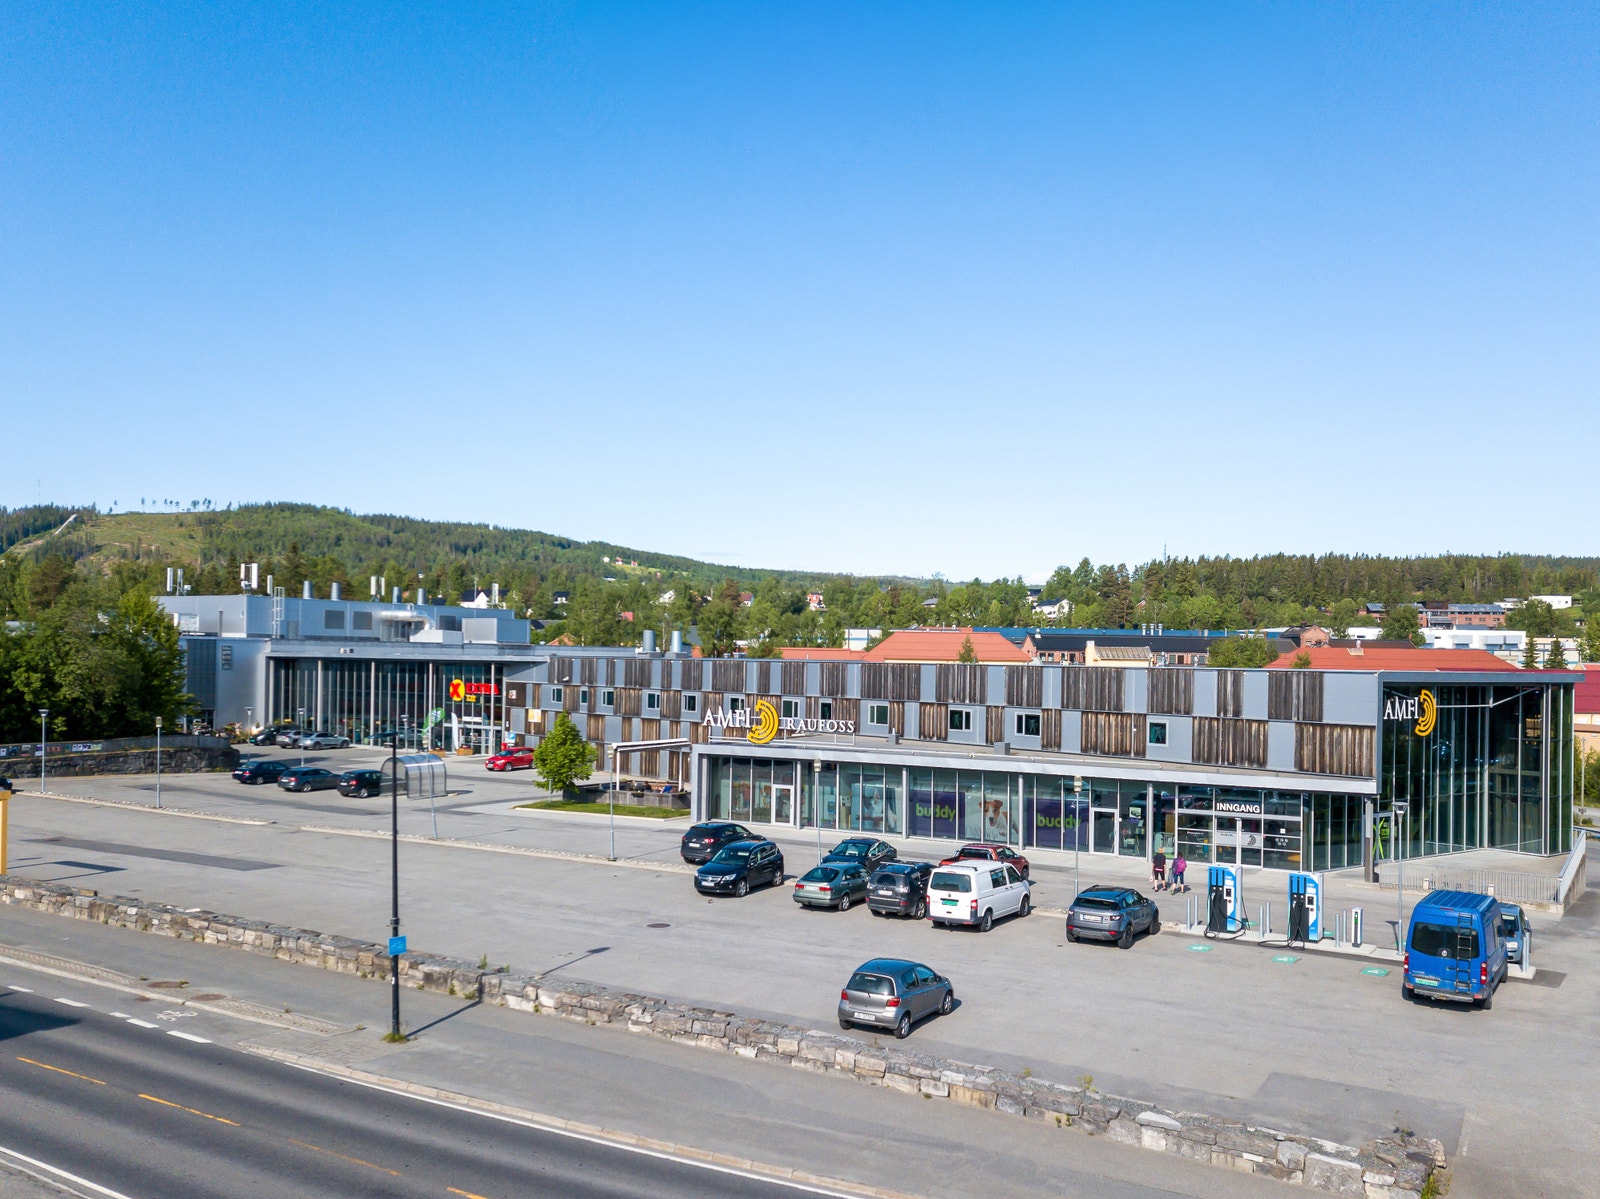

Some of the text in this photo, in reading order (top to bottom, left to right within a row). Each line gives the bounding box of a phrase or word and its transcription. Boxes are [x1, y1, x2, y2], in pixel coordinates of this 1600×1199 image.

[702, 706, 855, 733] AMFI RAUFOSS
[1383, 696, 1419, 721] AMFI
[915, 803, 956, 822] buddy
[1216, 802, 1260, 813] INNGANG
